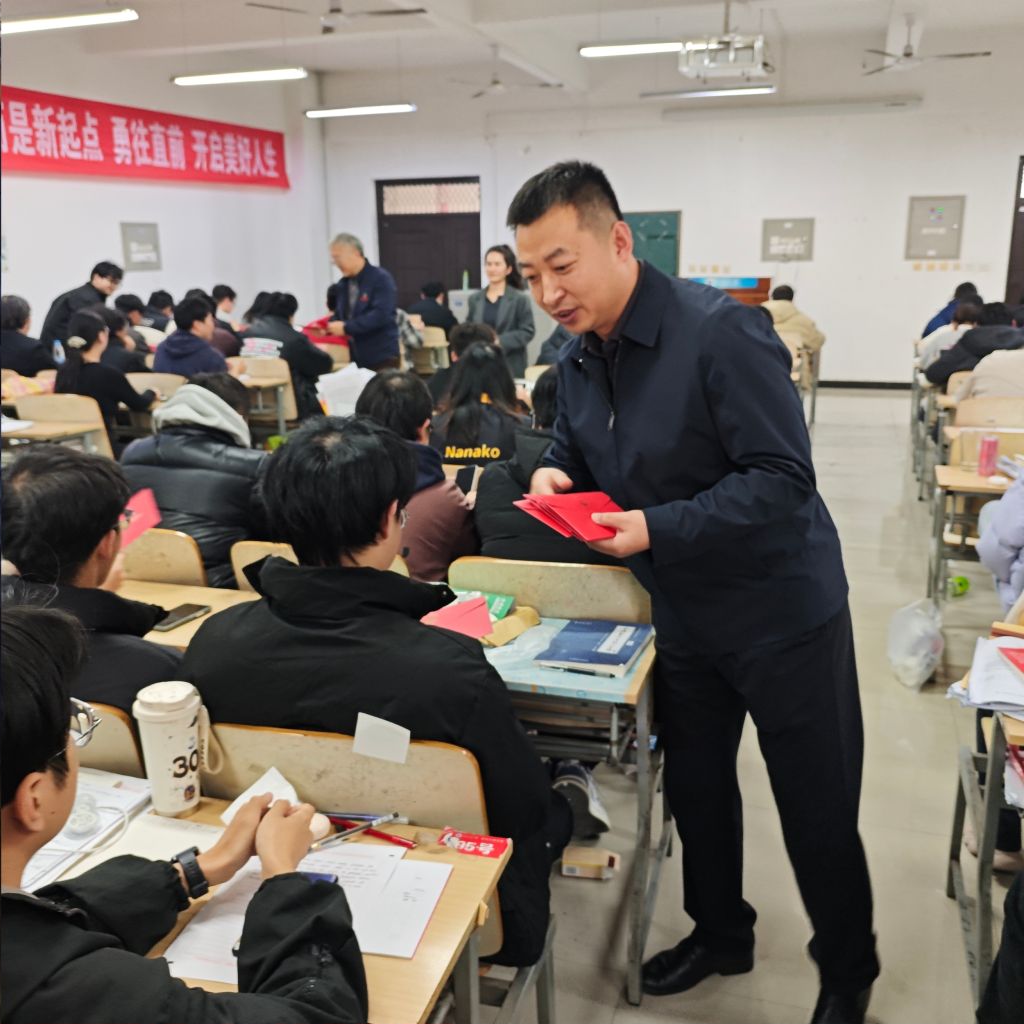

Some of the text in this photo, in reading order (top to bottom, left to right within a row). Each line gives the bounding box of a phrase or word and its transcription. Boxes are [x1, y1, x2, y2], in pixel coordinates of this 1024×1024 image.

[111, 115, 186, 170] 勇往直前
[191, 129, 279, 178] 开启美好人生
[445, 443, 501, 459] Nanako
[172, 748, 199, 779] 30
